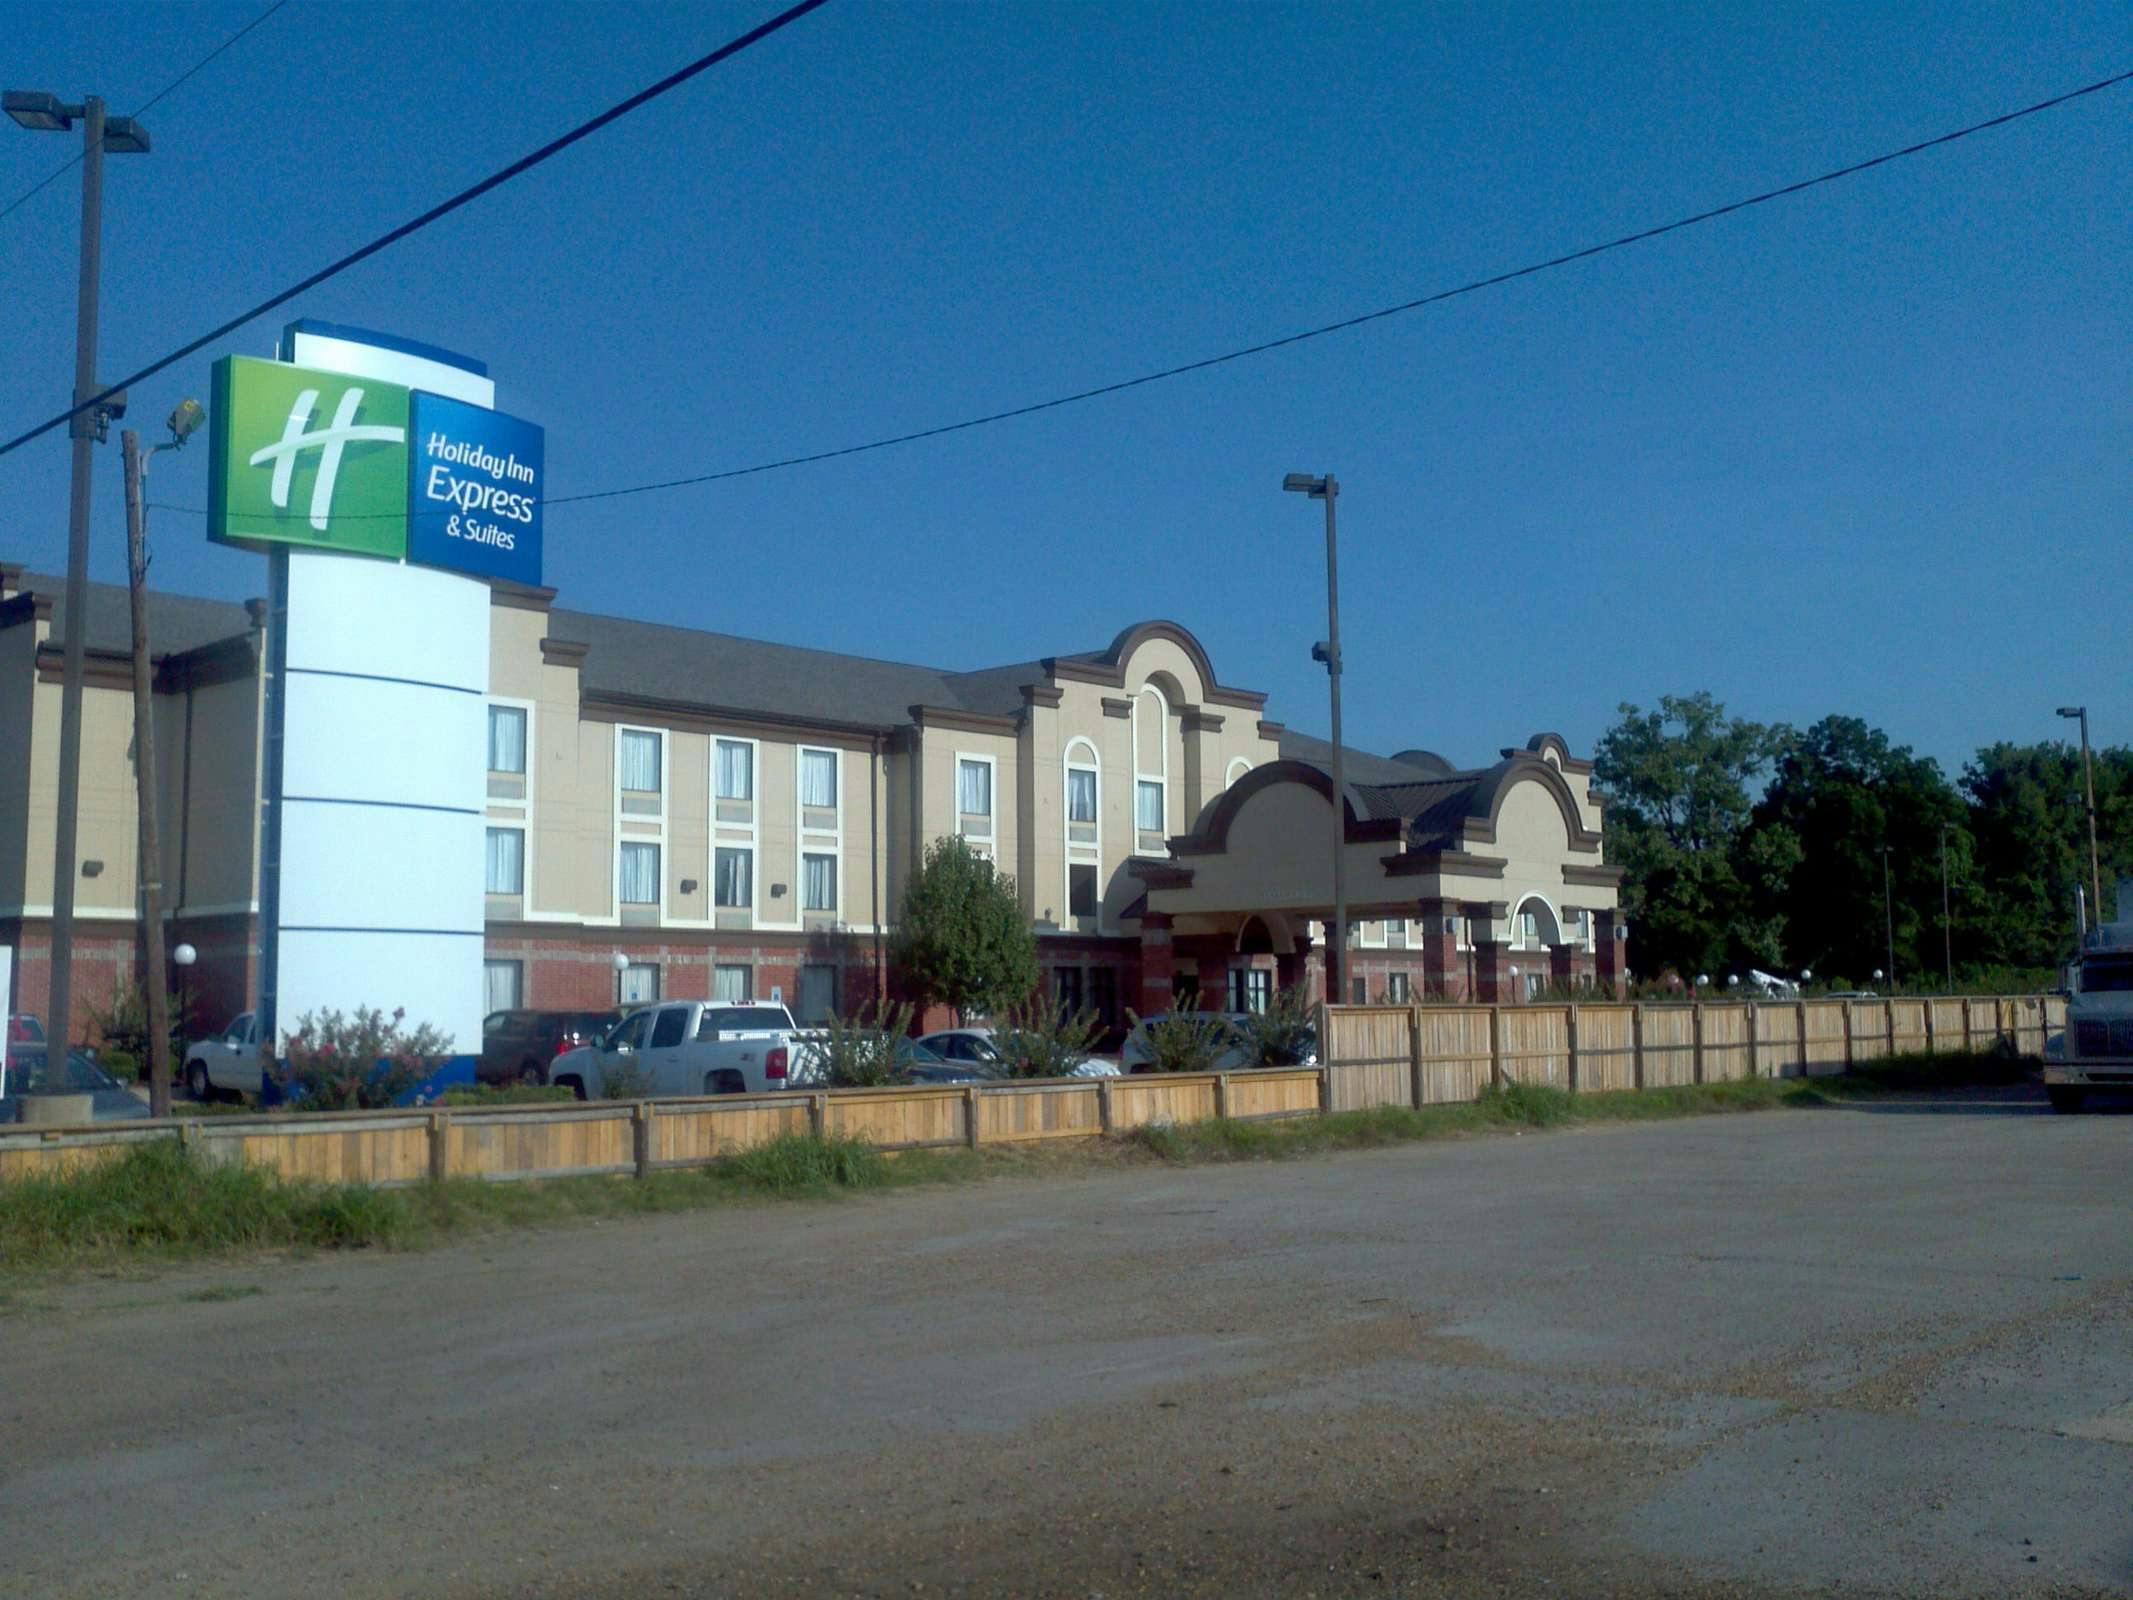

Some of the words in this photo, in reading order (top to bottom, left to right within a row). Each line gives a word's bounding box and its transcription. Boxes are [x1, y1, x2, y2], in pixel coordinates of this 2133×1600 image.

[426, 431, 506, 480] Holiday
[506, 453, 535, 485] Inn
[426, 464, 535, 523] Express
[446, 514, 461, 538] &
[463, 518, 515, 550] Suites
